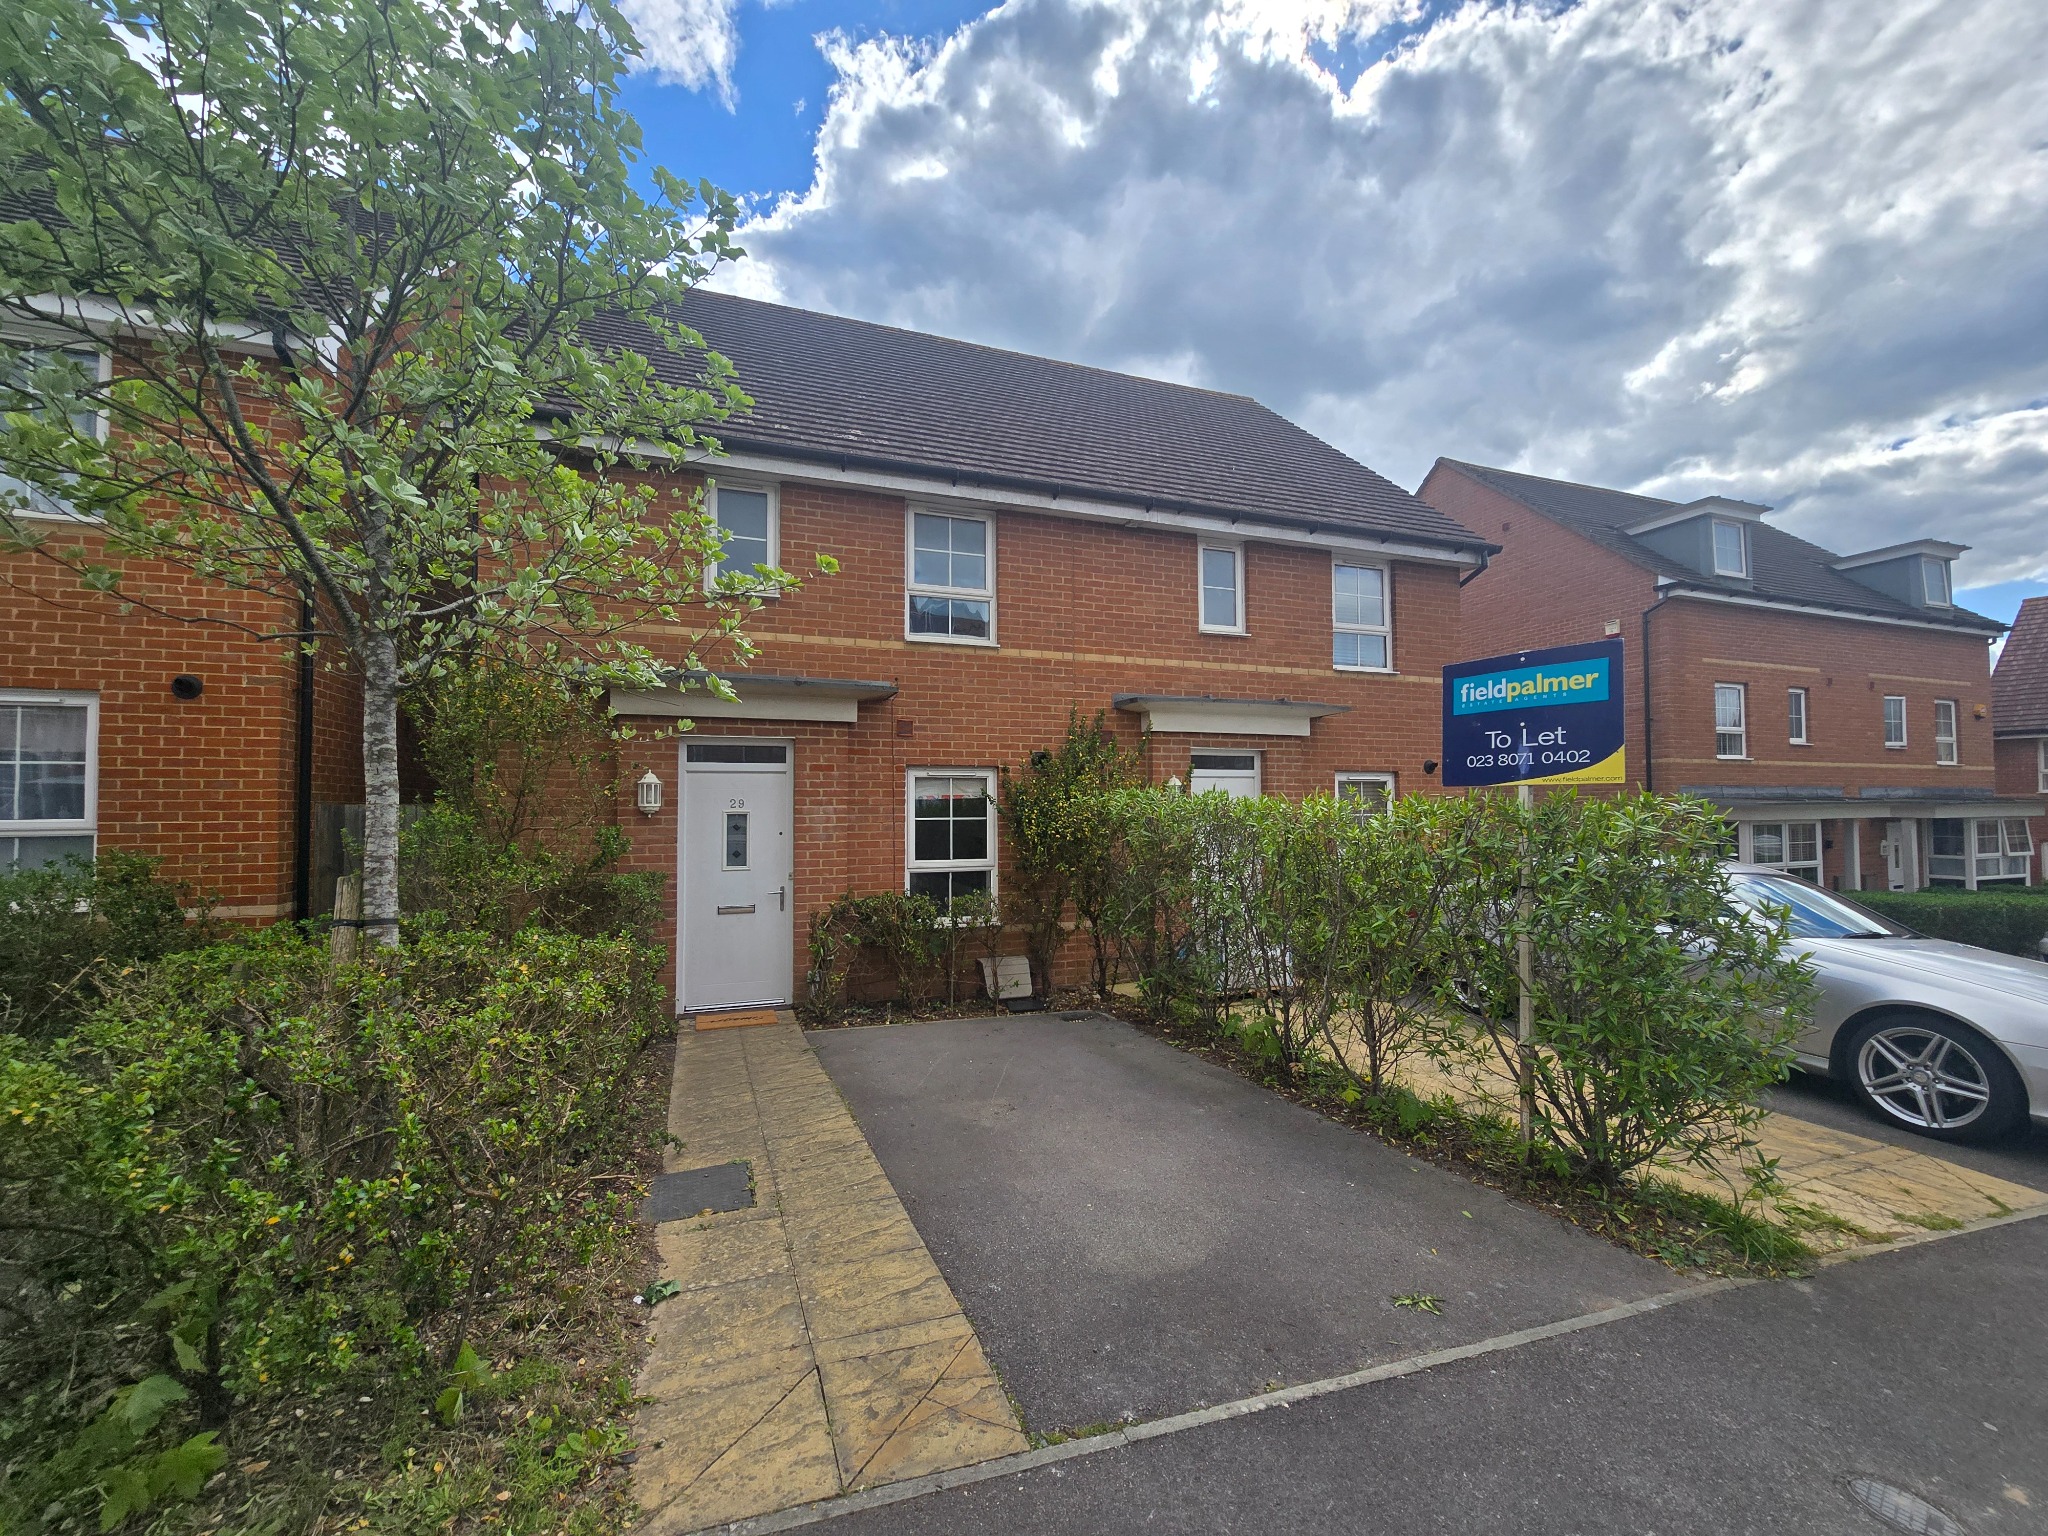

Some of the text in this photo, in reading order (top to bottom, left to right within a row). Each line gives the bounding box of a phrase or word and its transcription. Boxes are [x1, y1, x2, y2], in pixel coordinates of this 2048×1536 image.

[1461, 673, 1599, 702] fieldpalmer
[1462, 692, 1567, 708] ESTATE AGENTS
[1485, 726, 1567, 749] To Let
[1467, 750, 1591, 768] 023 8071 0402
[730, 798, 744, 808] 29
